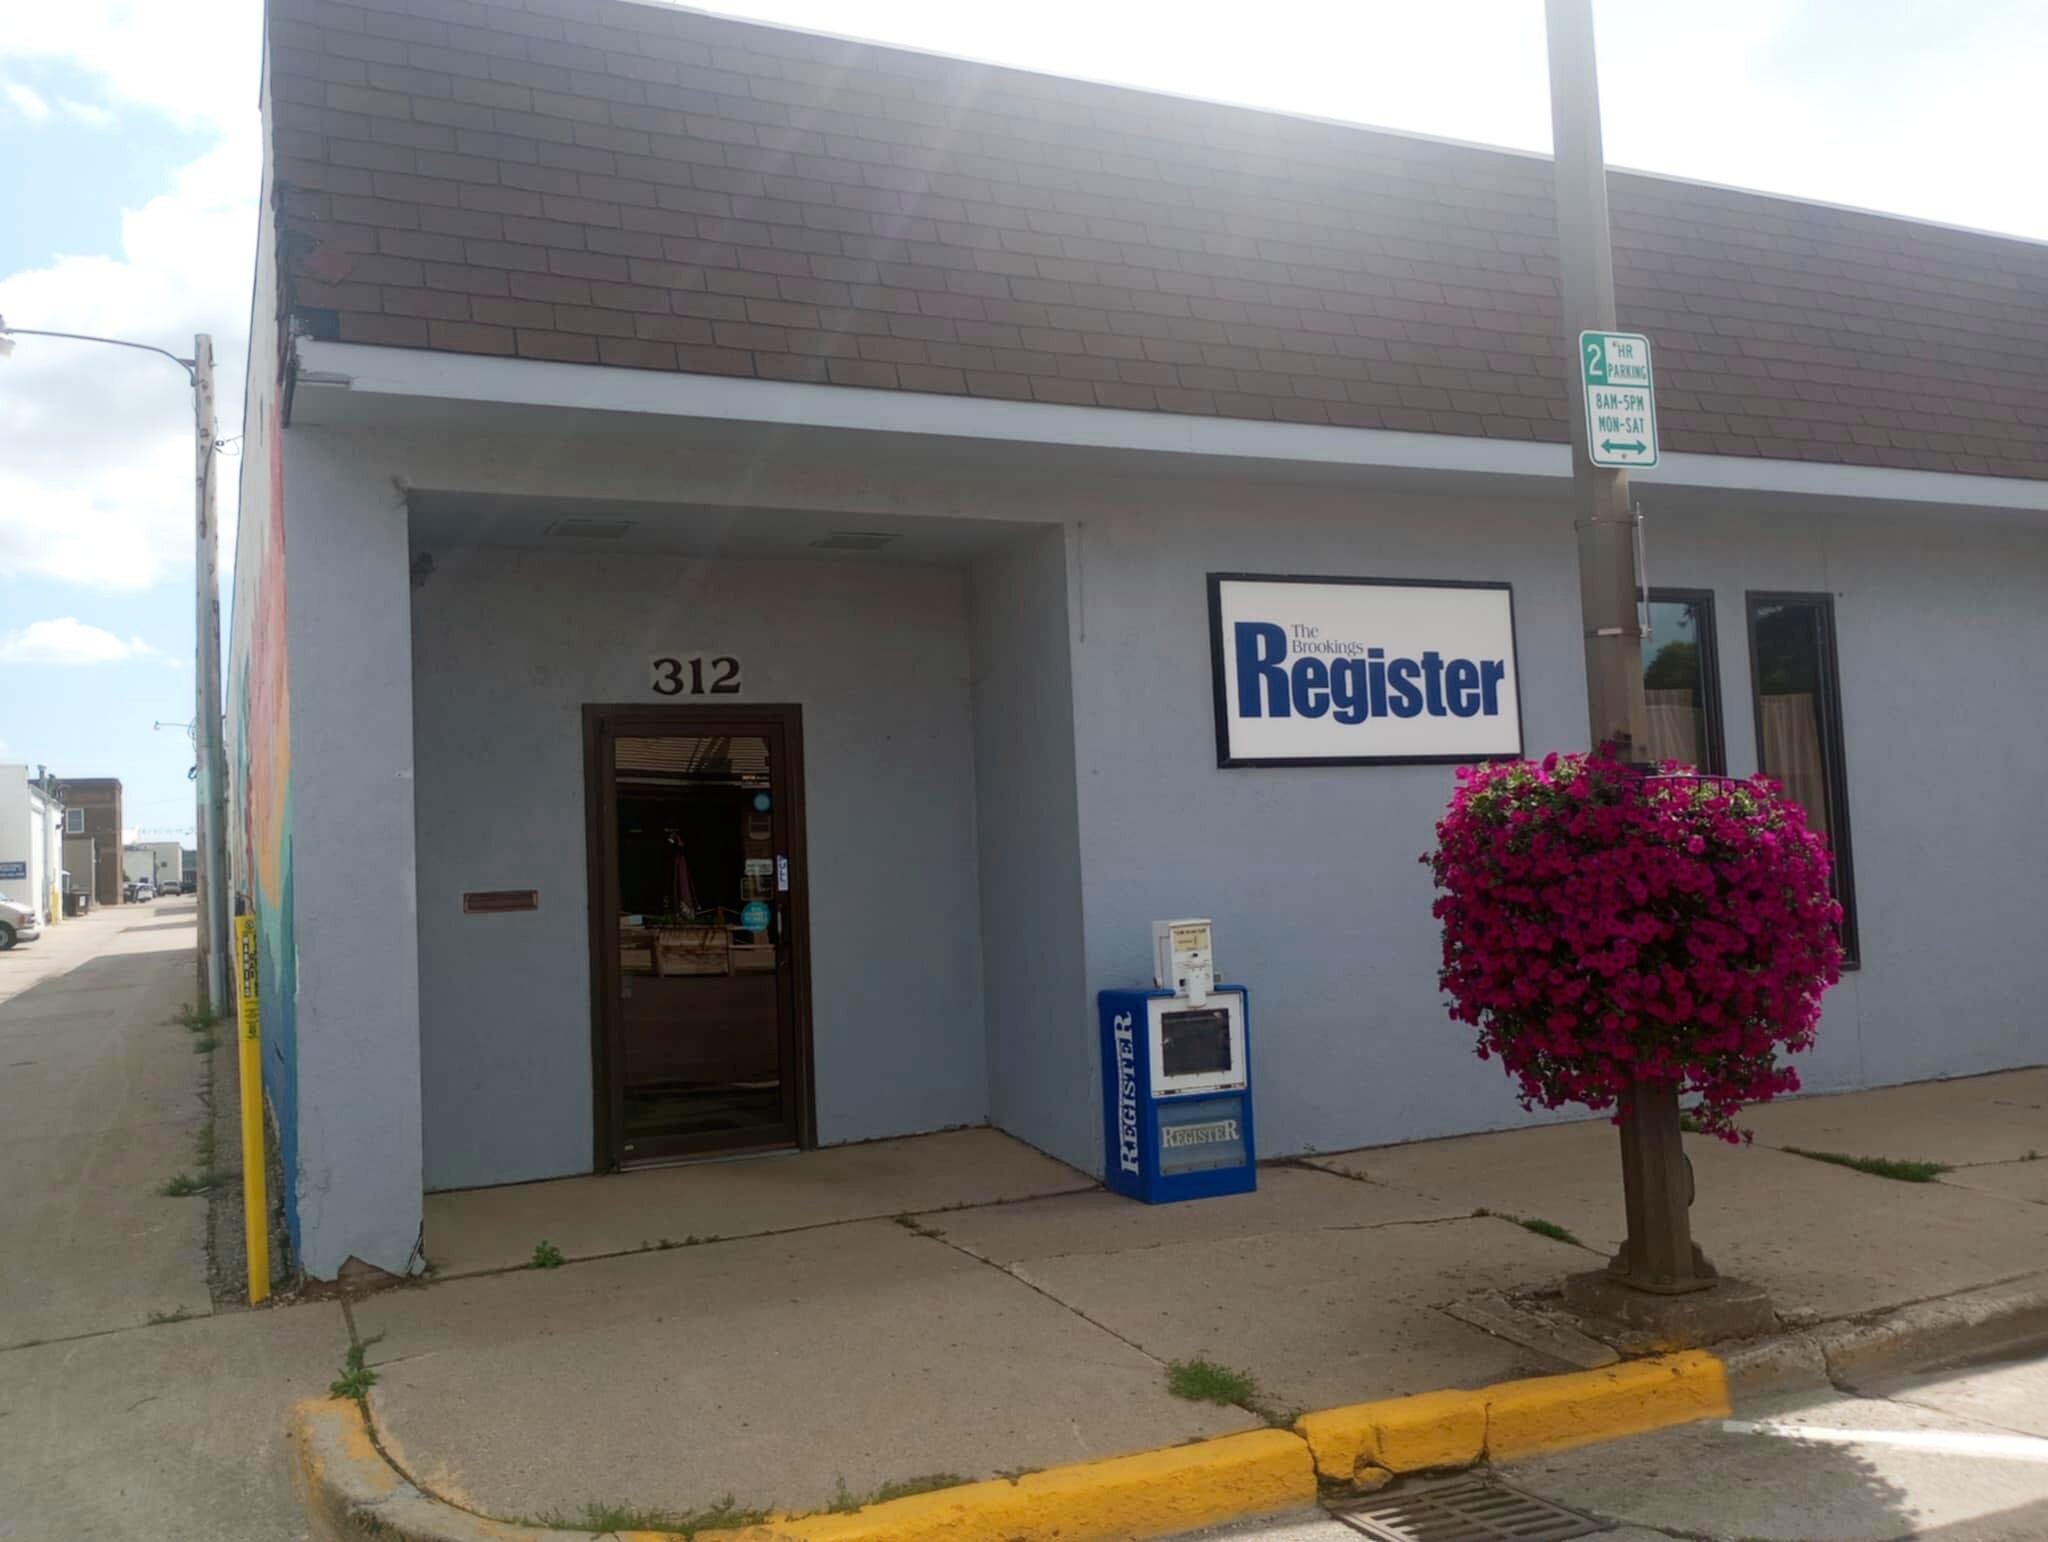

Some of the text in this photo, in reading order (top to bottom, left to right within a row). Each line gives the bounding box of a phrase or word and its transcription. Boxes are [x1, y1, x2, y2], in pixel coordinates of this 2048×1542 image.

[1587, 344, 1633, 375] 2 HR
[1608, 363, 1646, 380] PARKING
[1596, 393, 1644, 411] 8AM-5PM
[1599, 416, 1644, 433] MON-SAT
[1291, 623, 1319, 638] The
[1292, 639, 1364, 656] Brookings
[652, 657, 742, 696] 312
[1234, 621, 1505, 725] Register
[1113, 1011, 1140, 1176] REGISTER
[1162, 1119, 1240, 1149] REGISTER
